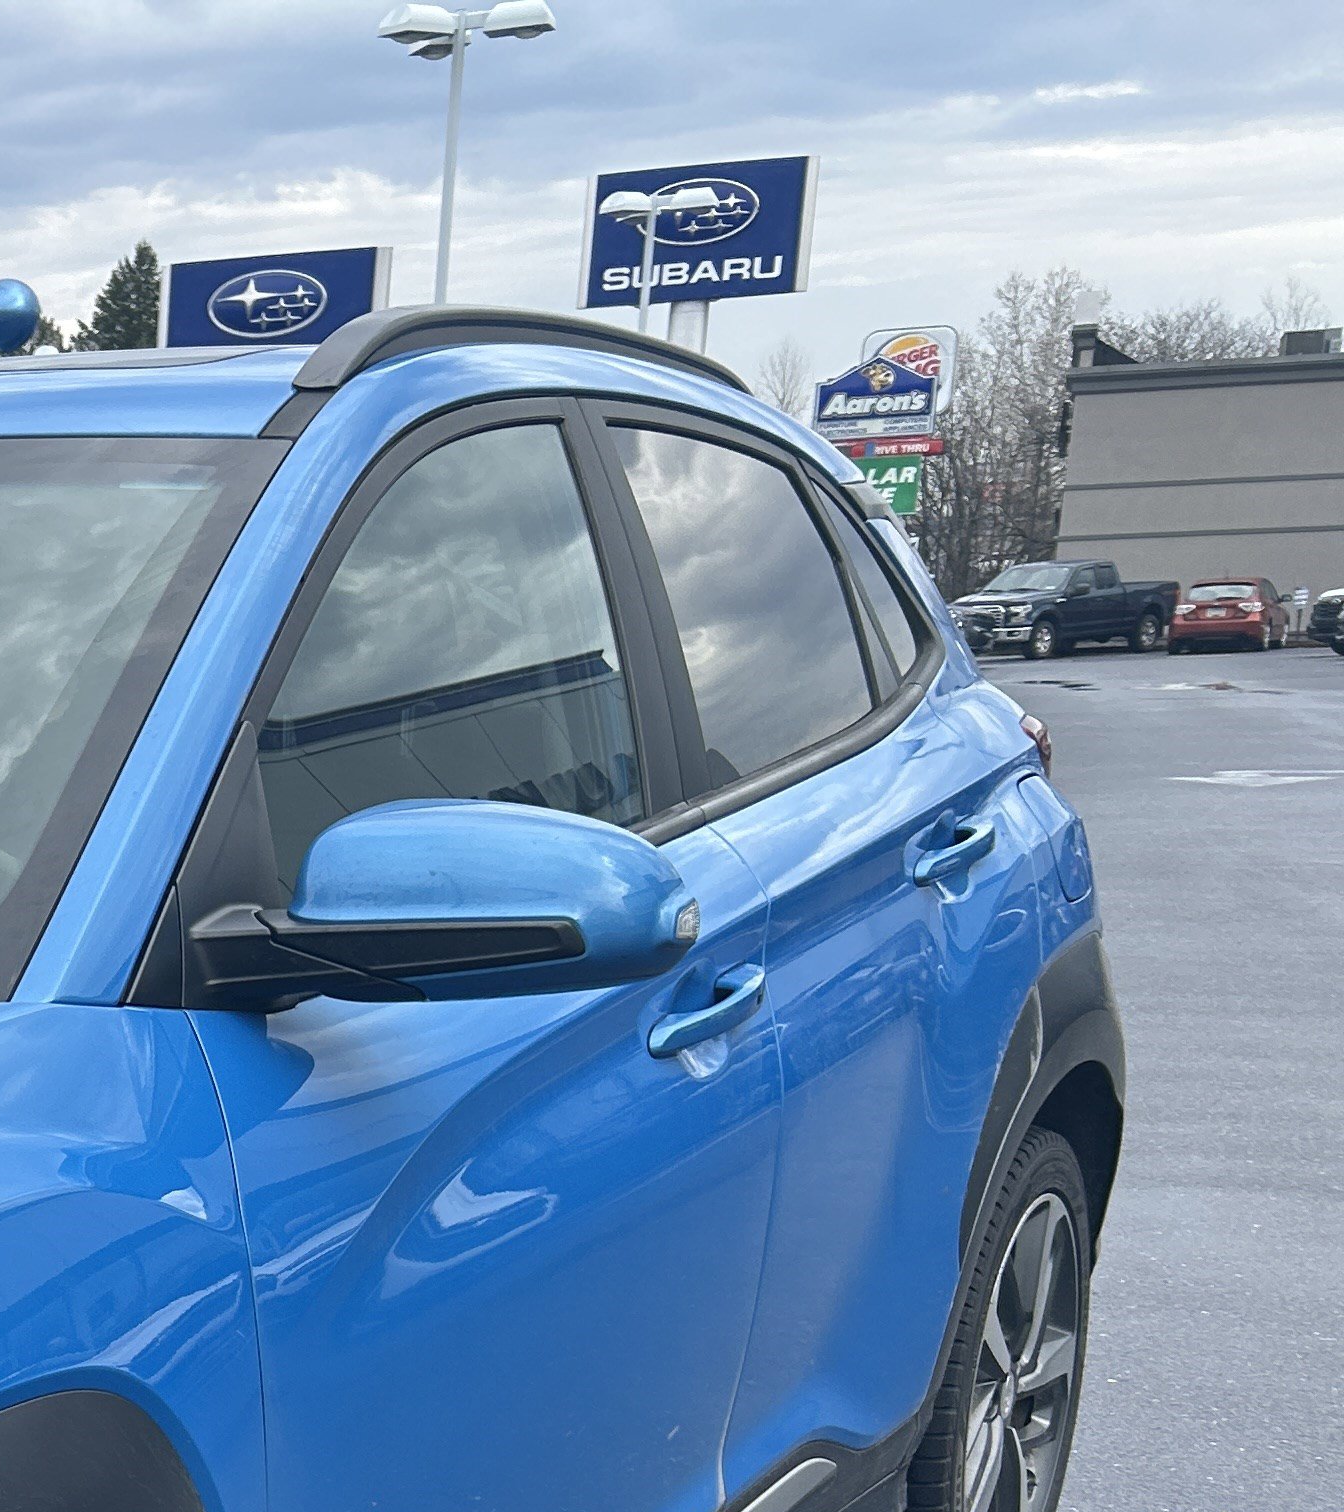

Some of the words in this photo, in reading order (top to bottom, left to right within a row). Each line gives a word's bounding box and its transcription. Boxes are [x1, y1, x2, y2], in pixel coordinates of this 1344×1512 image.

[602, 255, 784, 291] SUBARU
[821, 390, 928, 418] Aaron's
[901, 443, 930, 453] THRU
